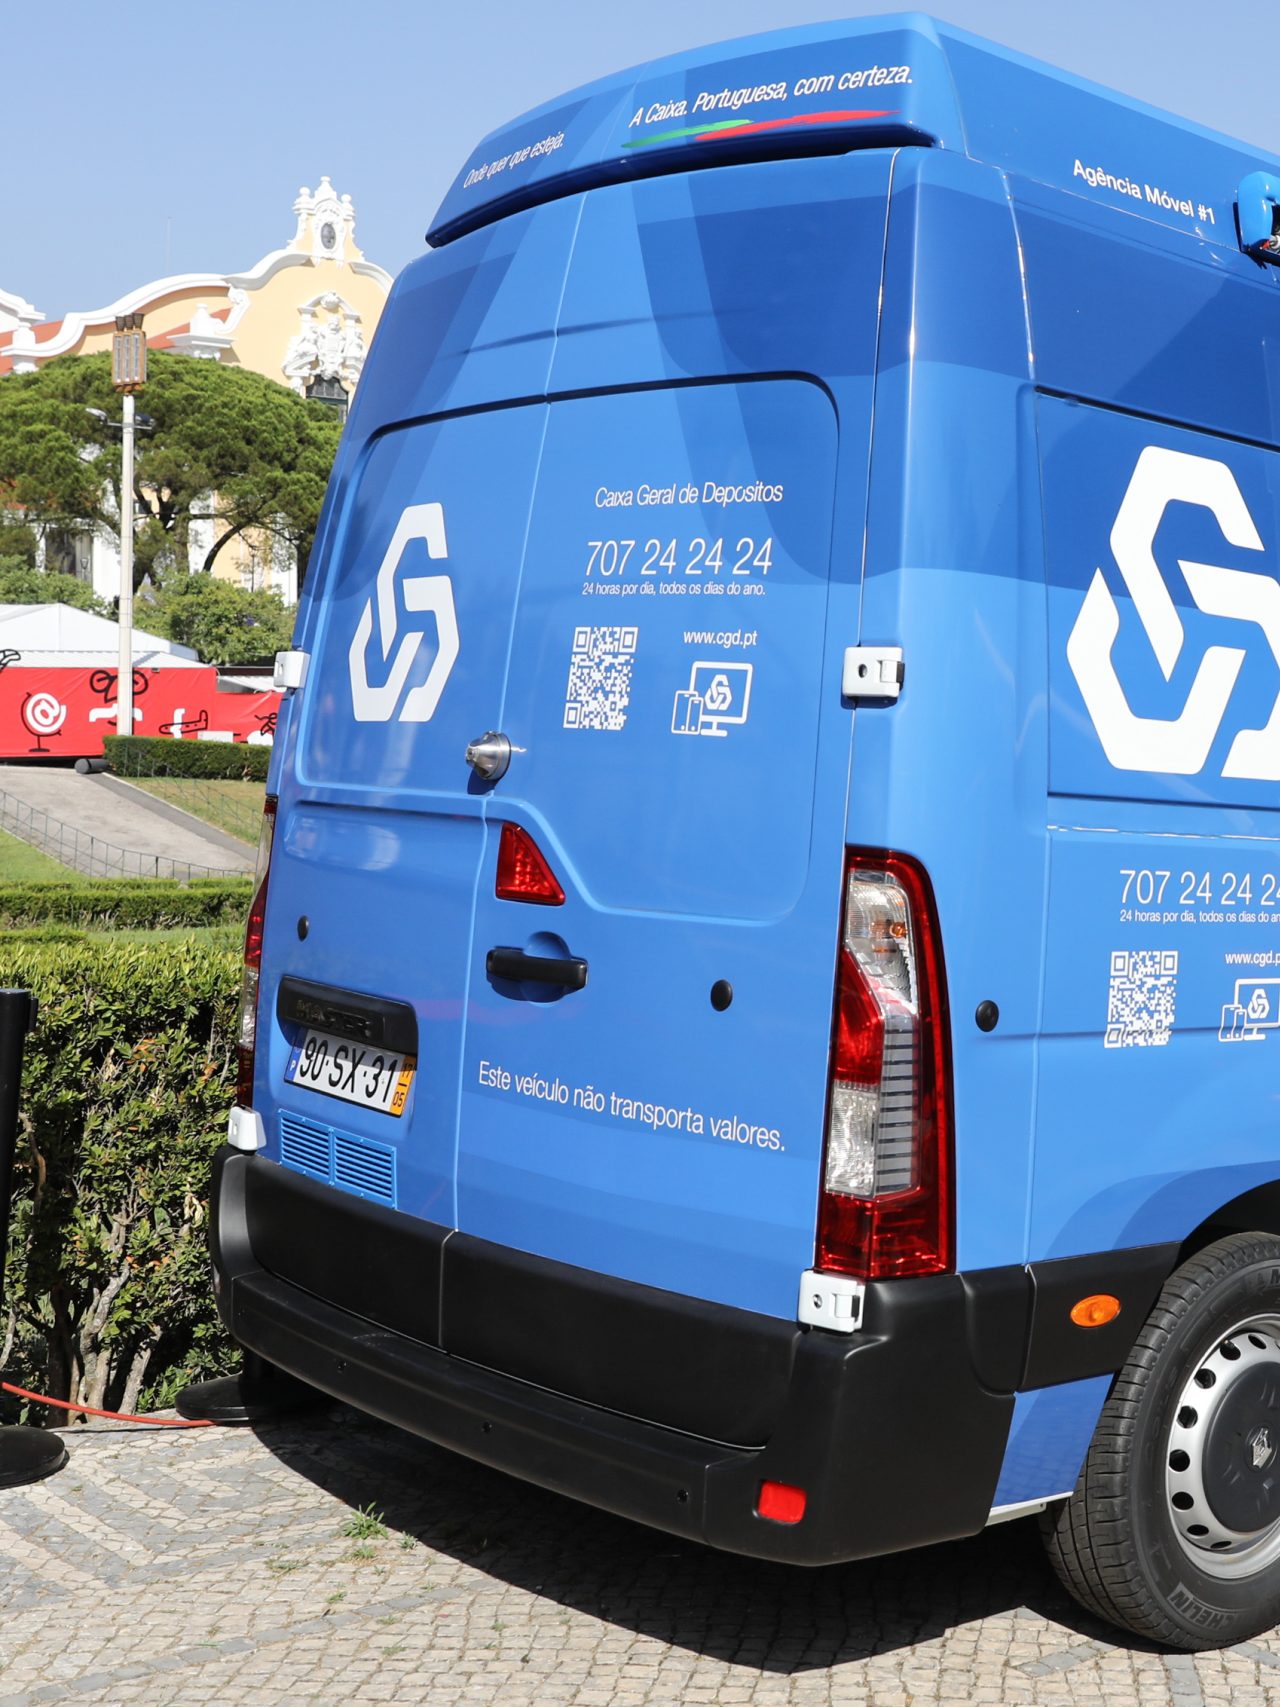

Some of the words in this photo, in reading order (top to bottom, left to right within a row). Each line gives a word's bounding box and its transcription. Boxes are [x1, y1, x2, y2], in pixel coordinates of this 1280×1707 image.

[629, 107, 642, 128] A
[644, 99, 688, 123] Caixa.
[692, 82, 788, 113] Portuguesa,
[793, 75, 834, 96] com
[837, 65, 913, 90] certeza.
[463, 163, 489, 188] Onde
[486, 154, 512, 180] quer
[509, 146, 531, 170] que
[1073, 159, 1143, 200] Agência
[1144, 184, 1195, 218] Móvel
[1198, 204, 1216, 225] #1
[595, 486, 634, 508] Caixa
[637, 483, 677, 506] Geral
[678, 483, 699, 504] de
[585, 539, 636, 577] 707
[640, 538, 677, 575] 24
[685, 537, 723, 575] 24
[732, 537, 773, 575] 24
[582, 582, 594, 595] 24
[595, 582, 620, 595] horas
[622, 583, 639, 597] por
[639, 581, 656, 596] dia,
[659, 582, 687, 594] todos
[689, 584, 702, 595] os
[703, 581, 724, 595] dias
[726, 581, 741, 595] do
[743, 584, 766, 596] ano.
[683, 629, 758, 649] www.cgd.pt
[1119, 870, 1171, 904] 707
[1179, 871, 1213, 905] 24
[1220, 872, 1253, 905] 24
[1119, 909, 1132, 922] 24
[1134, 909, 1161, 922] horas
[1163, 911, 1179, 925] por
[1180, 910, 1196, 923] dia,
[1199, 910, 1224, 922] todos
[1226, 912, 1237, 923] os
[1238, 911, 1256, 923] dias
[1257, 911, 1270, 923] do
[479, 1060, 511, 1090] Este
[515, 1072, 569, 1104] veículo
[573, 1086, 605, 1112] não
[610, 1091, 704, 1134] transporta
[710, 1115, 785, 1152] valores.
